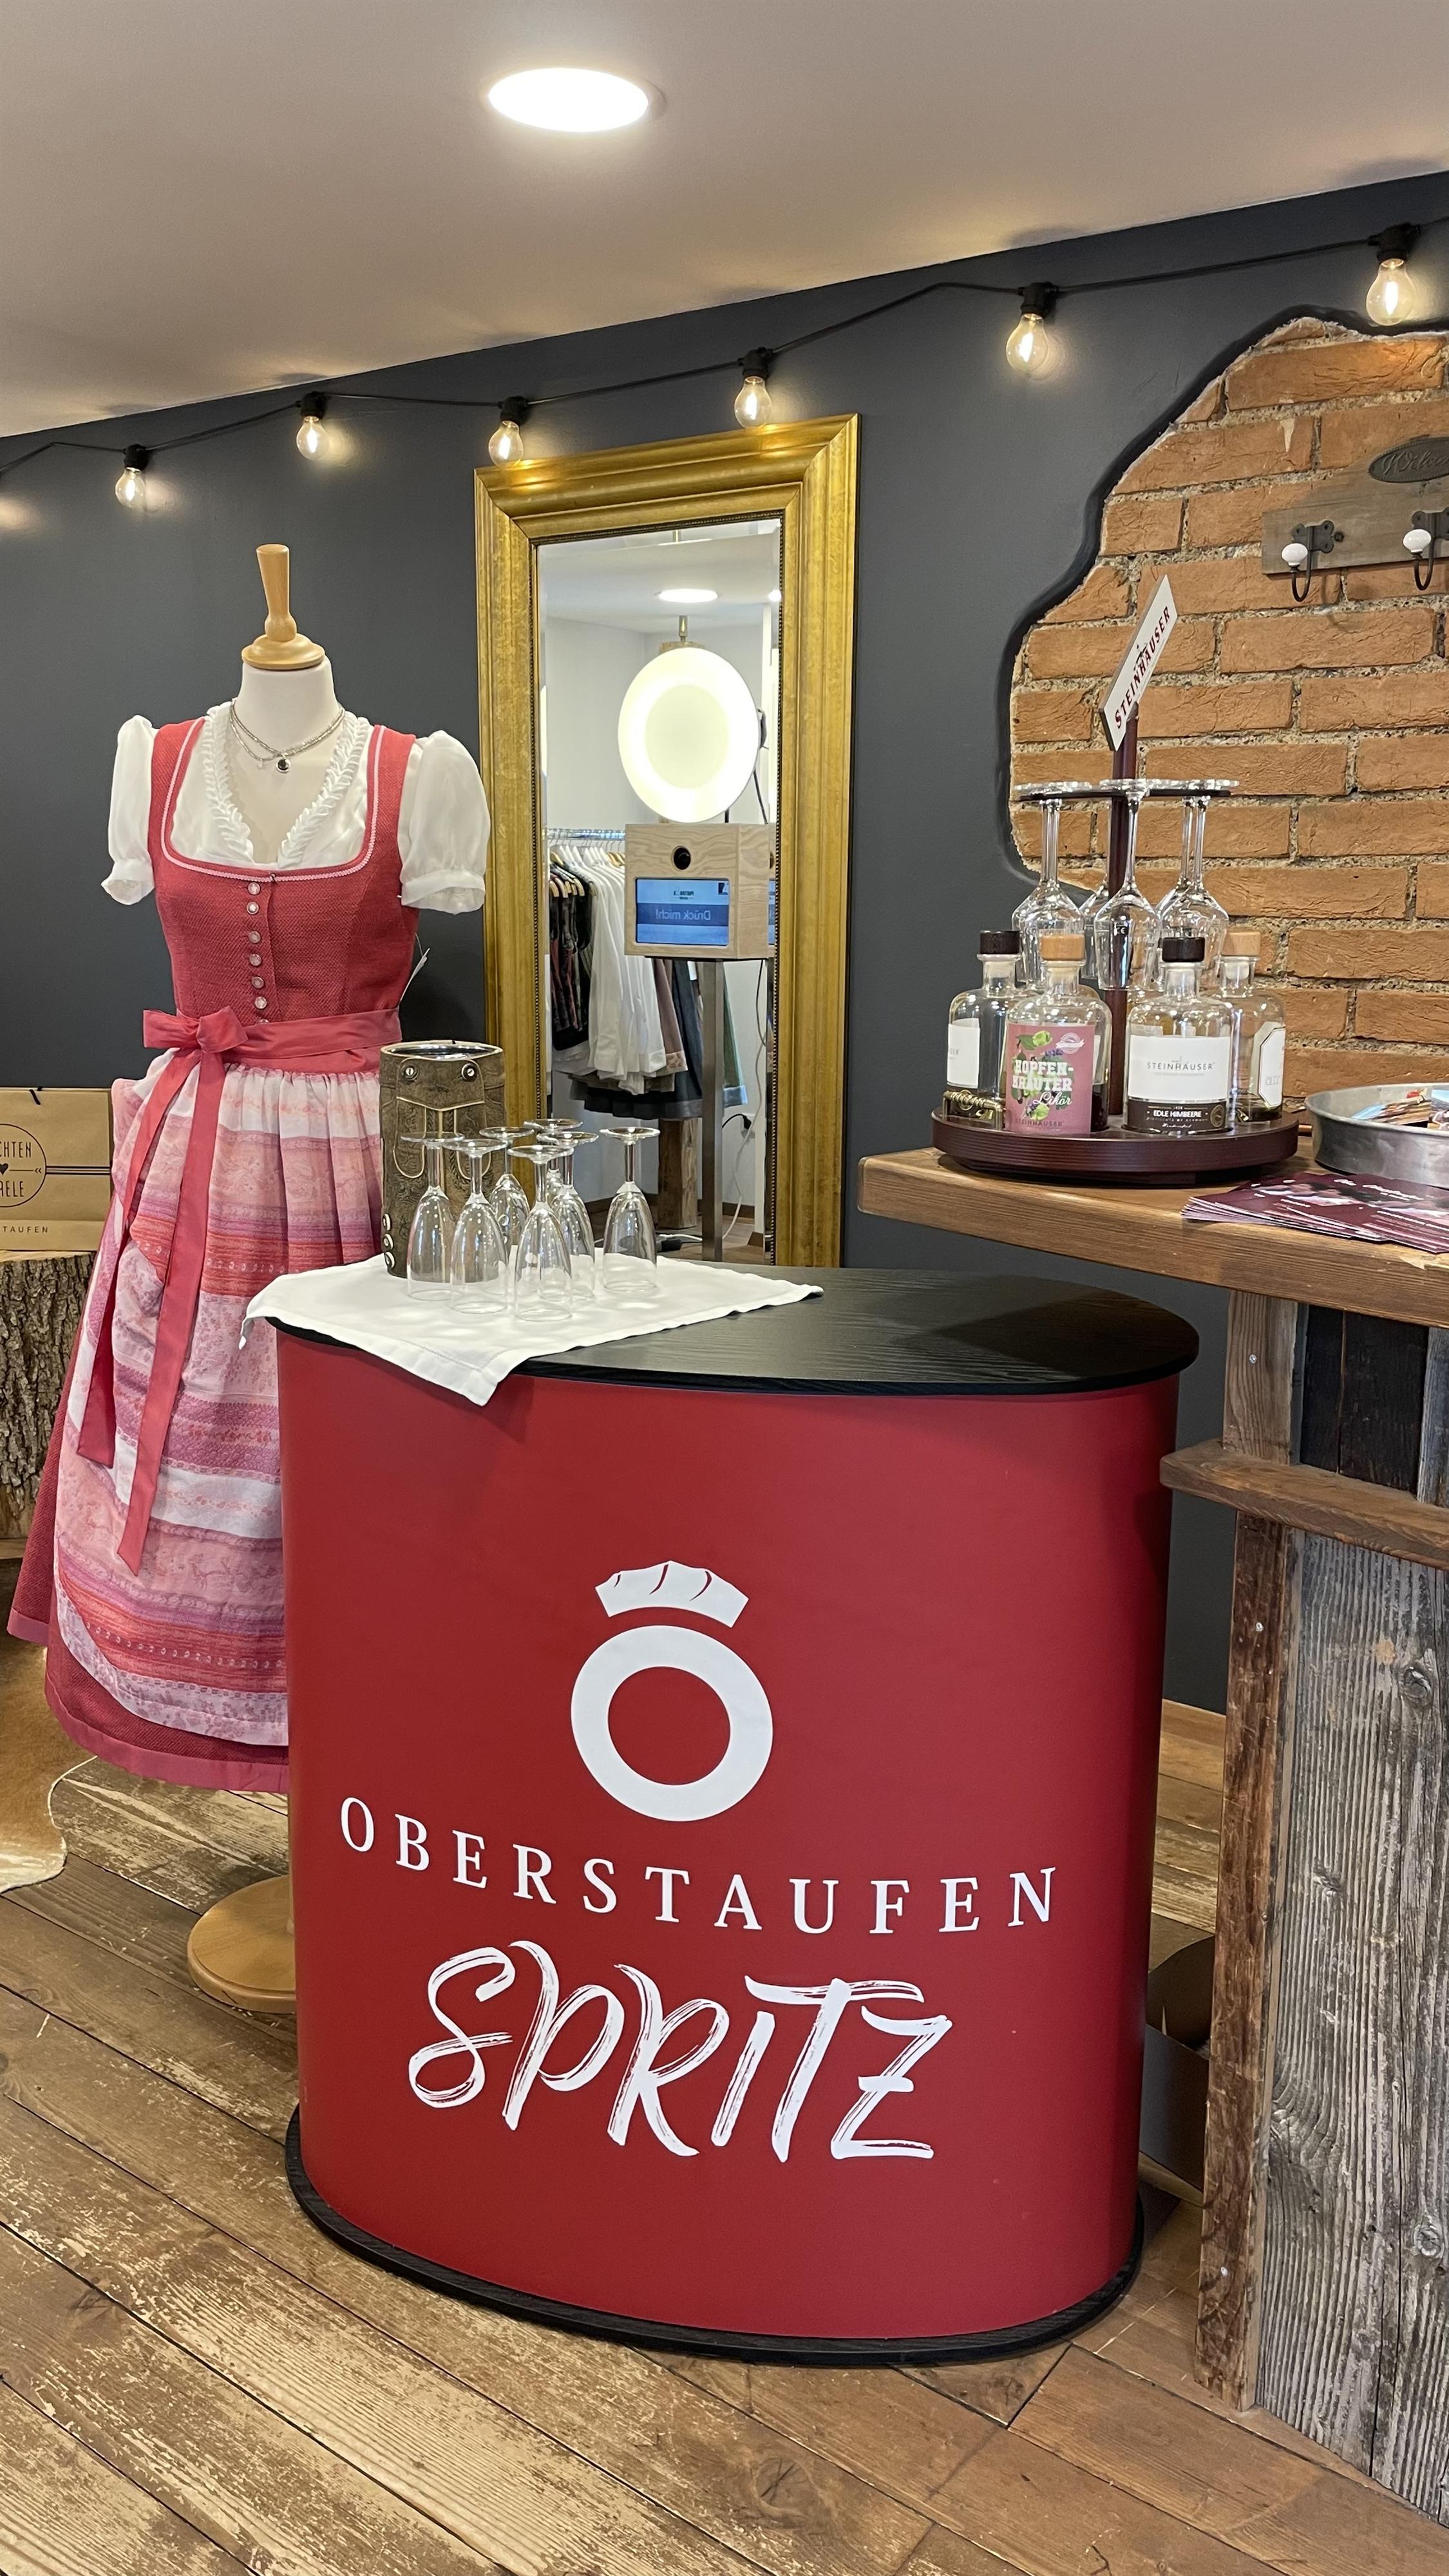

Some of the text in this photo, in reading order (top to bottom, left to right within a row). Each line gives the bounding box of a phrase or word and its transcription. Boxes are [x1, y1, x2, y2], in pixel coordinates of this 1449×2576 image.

[1014, 1059, 1074, 1076] HOPFEN-
[1032, 1091, 1072, 1106] Likör
[341, 1797, 1056, 1934] OBERSTAUFEN
[408, 1940, 953, 2163] SPRITZ
